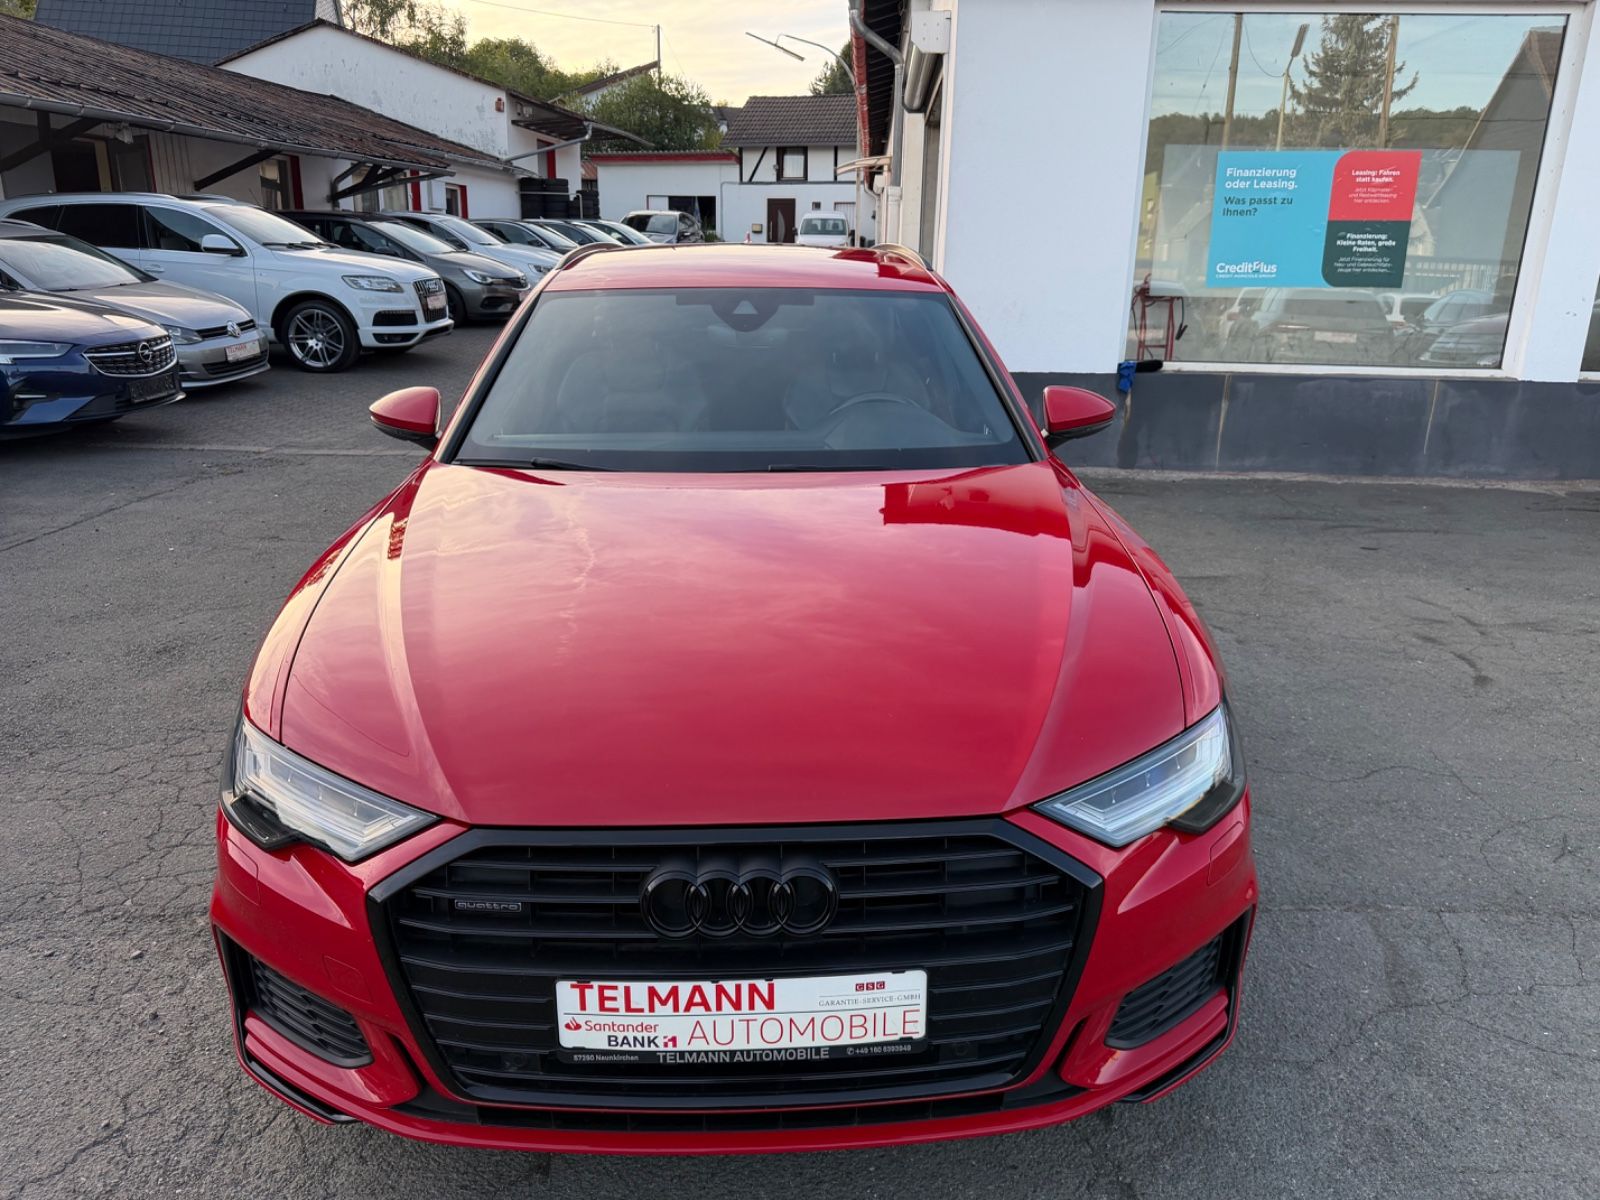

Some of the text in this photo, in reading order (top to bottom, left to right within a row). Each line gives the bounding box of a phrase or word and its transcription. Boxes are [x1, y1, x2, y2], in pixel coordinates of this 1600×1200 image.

[1226, 167, 1297, 178] Finanzierung
[1225, 179, 1299, 190] oder Leasing.
[1224, 196, 1294, 207] Was passt zu
[1221, 207, 1259, 217] Ihnen?
[1216, 260, 1278, 273] CreditPlus
[457, 902, 518, 910] quattro
[570, 982, 775, 1013] TELMANN
[584, 1020, 660, 1033] Santander
[687, 1008, 920, 1046] AUTOMOBILE
[607, 1035, 659, 1048] BANK
[656, 1047, 829, 1063] TELMANN AUTOMOBILE
